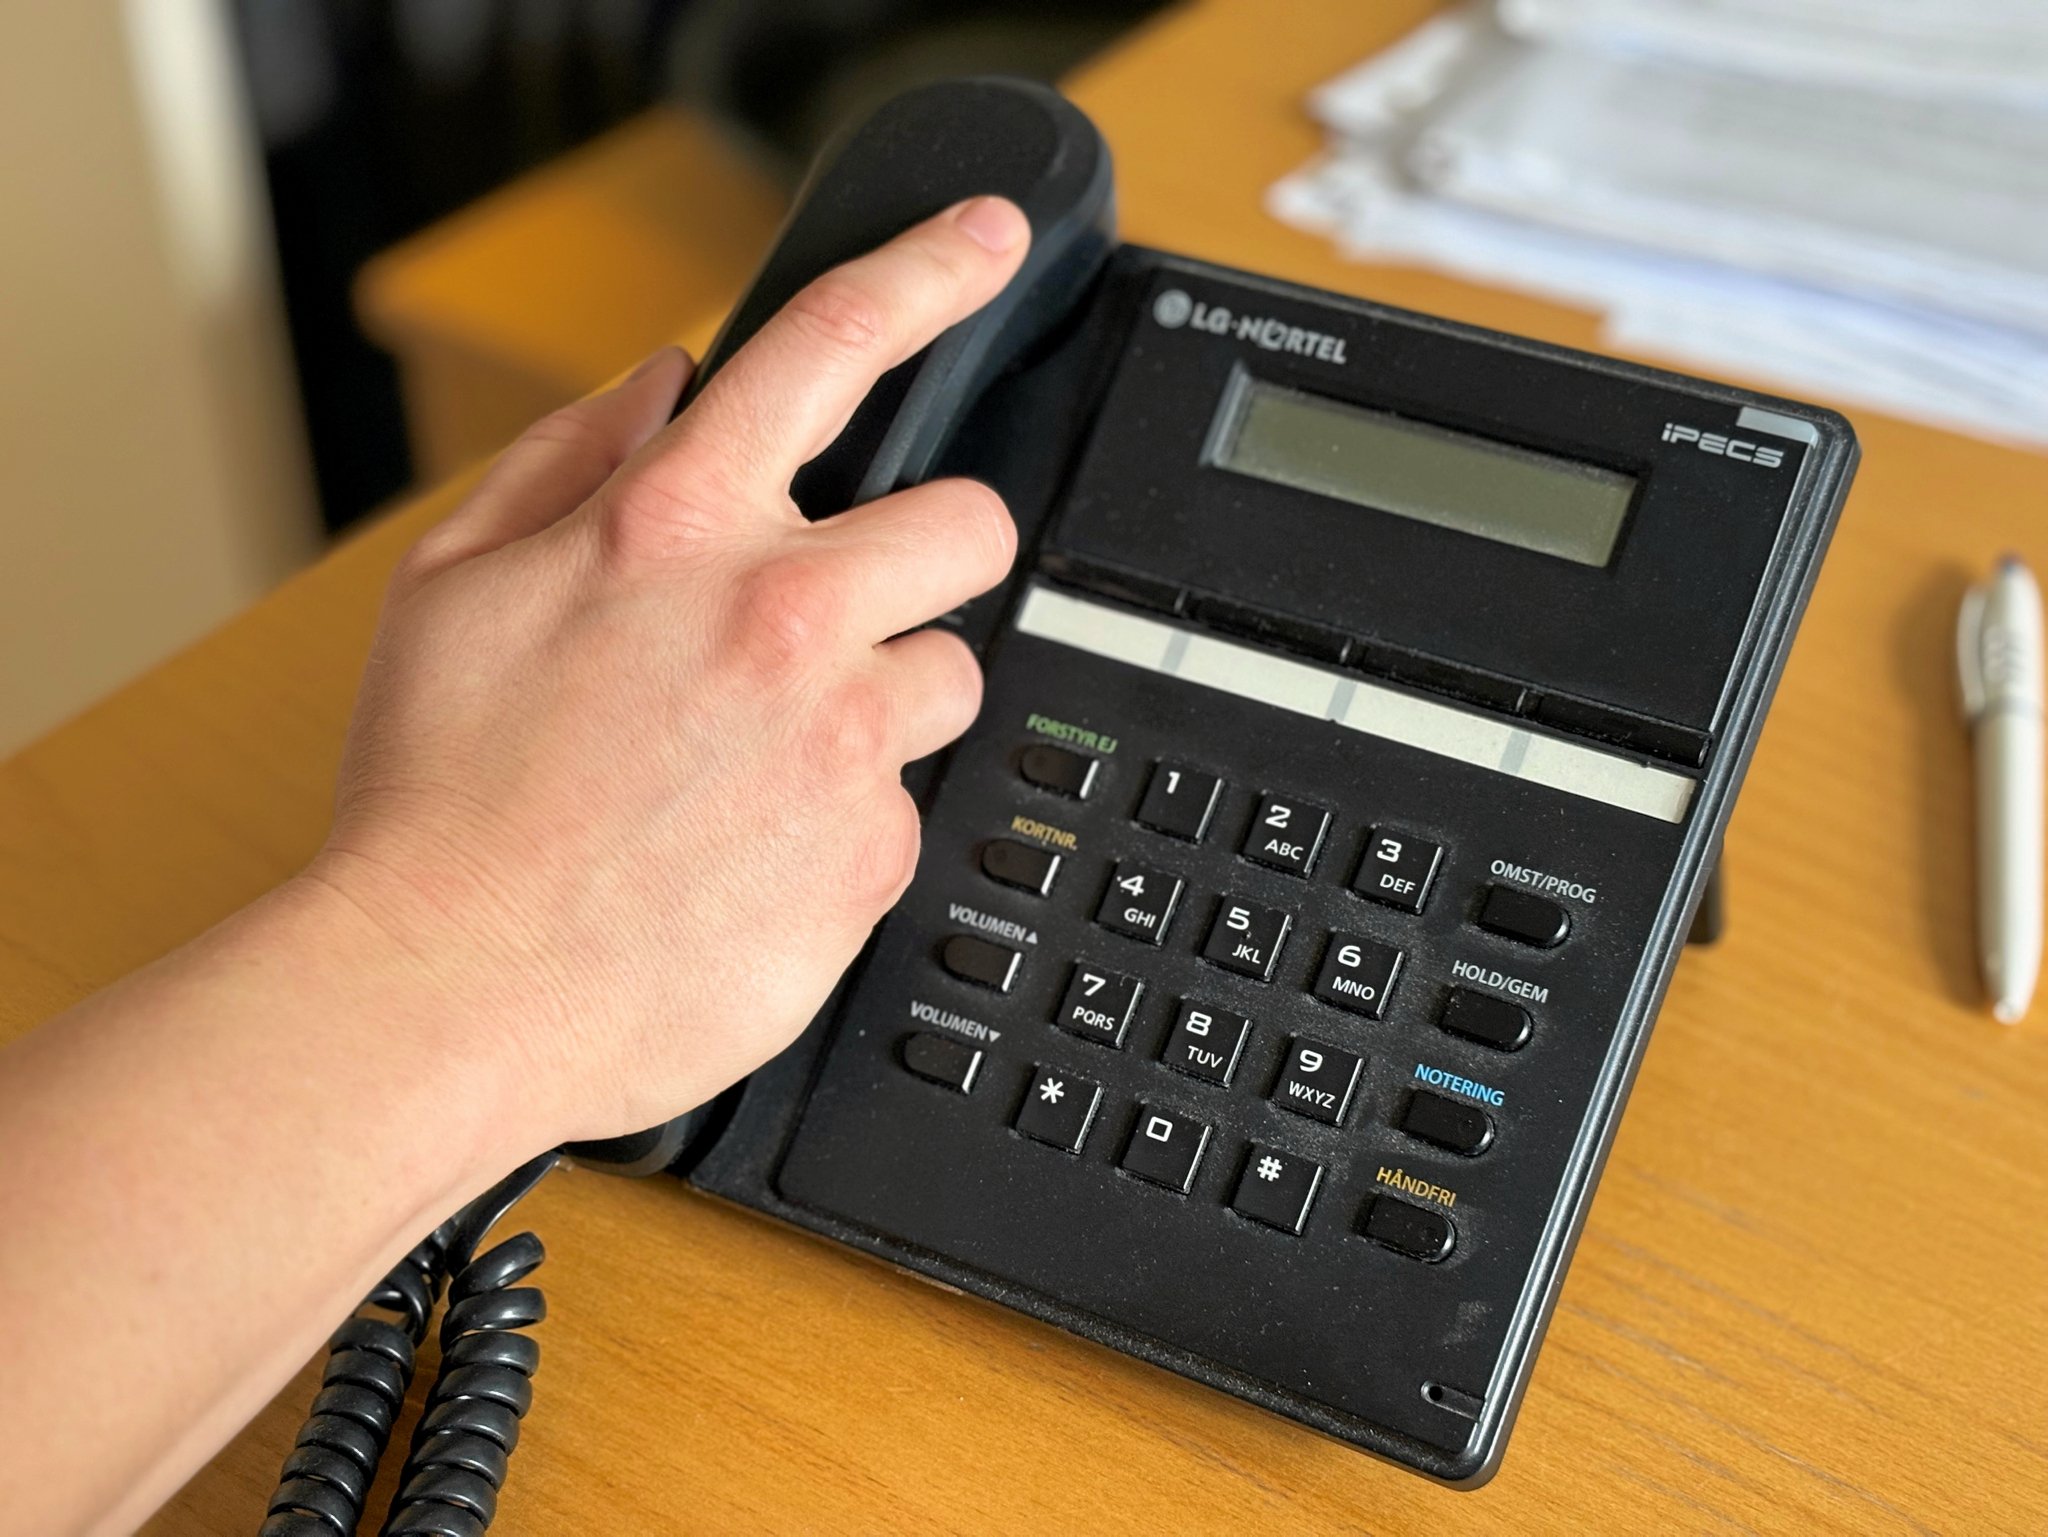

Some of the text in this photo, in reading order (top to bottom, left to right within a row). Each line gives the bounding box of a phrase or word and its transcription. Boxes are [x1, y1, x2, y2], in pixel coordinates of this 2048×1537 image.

[1026, 713, 1118, 754] FORSTYR EJ
[1167, 772, 1180, 793] 1
[1266, 805, 1291, 828] 2
[1012, 816, 1077, 850] KORTNR.
[1265, 839, 1303, 860] ABC
[1377, 839, 1401, 862] 3
[1120, 875, 1145, 896] 4
[1380, 874, 1415, 893] DEF
[1491, 860, 1596, 903] OMST/PROG
[949, 903, 1026, 942] VOLUMEN
[1124, 908, 1156, 928] GHI
[1227, 907, 1249, 930] 5
[1232, 944, 1260, 963] JKL
[1338, 946, 1361, 967] 6
[1083, 974, 1105, 996] 7
[1333, 977, 1374, 1000] MNO
[1451, 959, 1549, 1003] HOLD/GEM
[910, 1000, 988, 1041] VOLUMEN
[1073, 1006, 1114, 1030] PQRS
[1186, 1012, 1212, 1036] 8
[1188, 1046, 1222, 1067] TUV
[1300, 1050, 1323, 1072] 9
[1289, 1081, 1335, 1108] WXYZ
[1415, 1064, 1504, 1106] NOTERING
[1146, 1117, 1172, 1142] 0
[1376, 1165, 1457, 1208] HÅNDFRI
